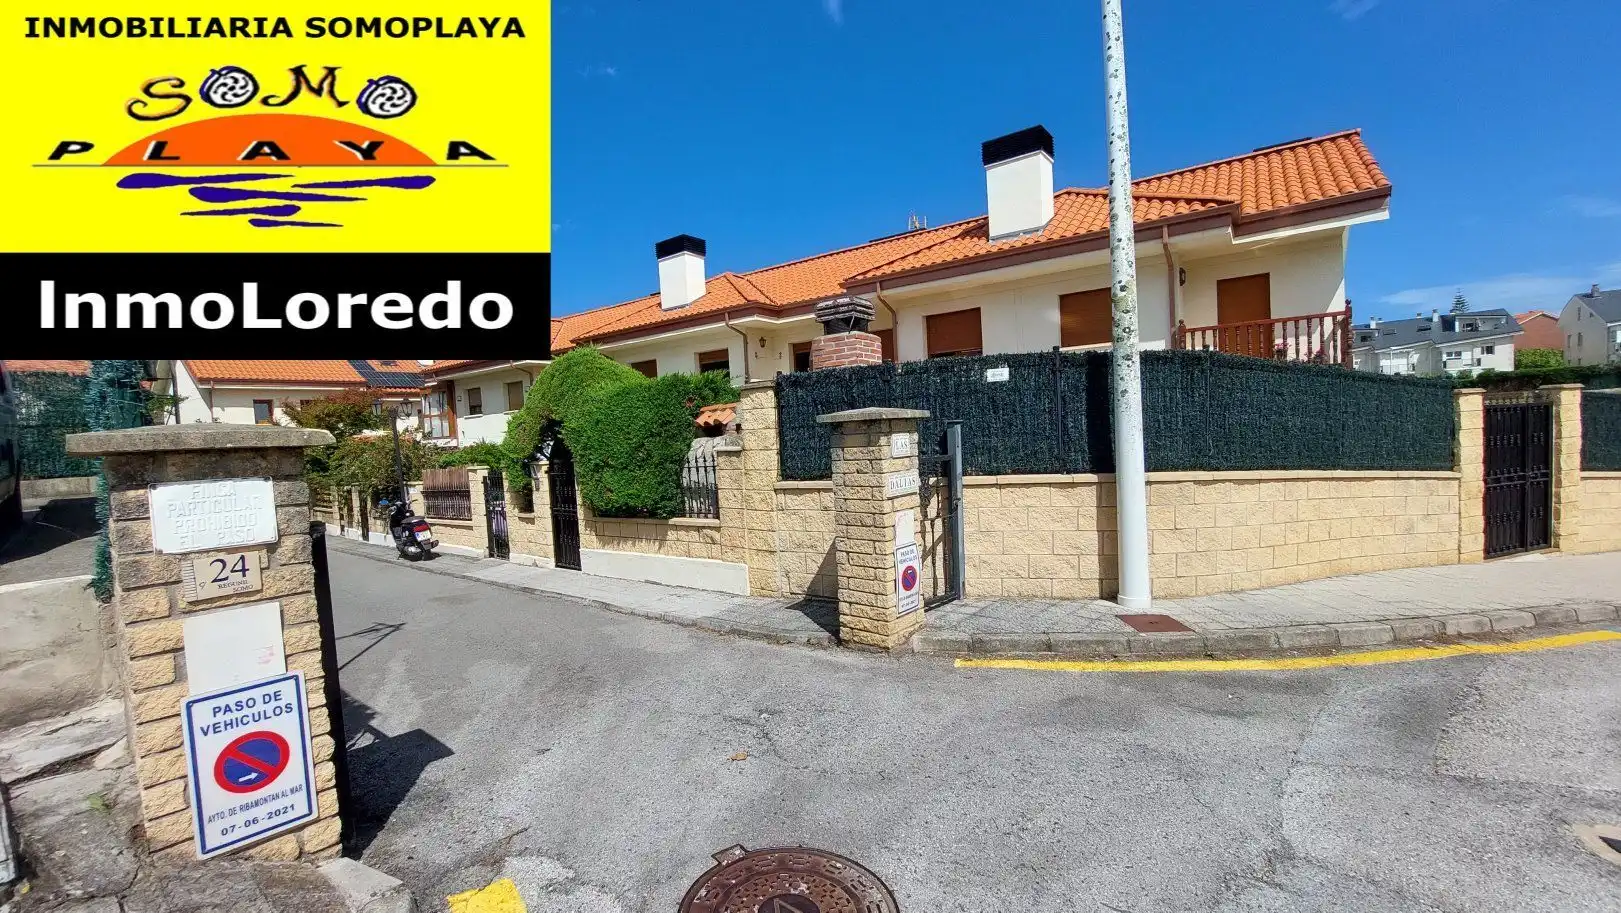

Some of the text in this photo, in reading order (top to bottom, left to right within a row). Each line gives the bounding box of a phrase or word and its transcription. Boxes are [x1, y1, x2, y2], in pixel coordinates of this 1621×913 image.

[167, 496, 263, 518] PARTICULAR
[174, 513, 258, 535] PROHIBIDO
[217, 529, 257, 547] PASO
[209, 554, 250, 583] 24
[212, 689, 283, 718] PASO DE
[200, 702, 294, 737] VEHICULOS
[208, 783, 304, 824] AYTO. DE RIBAMONTAN AL MAR
